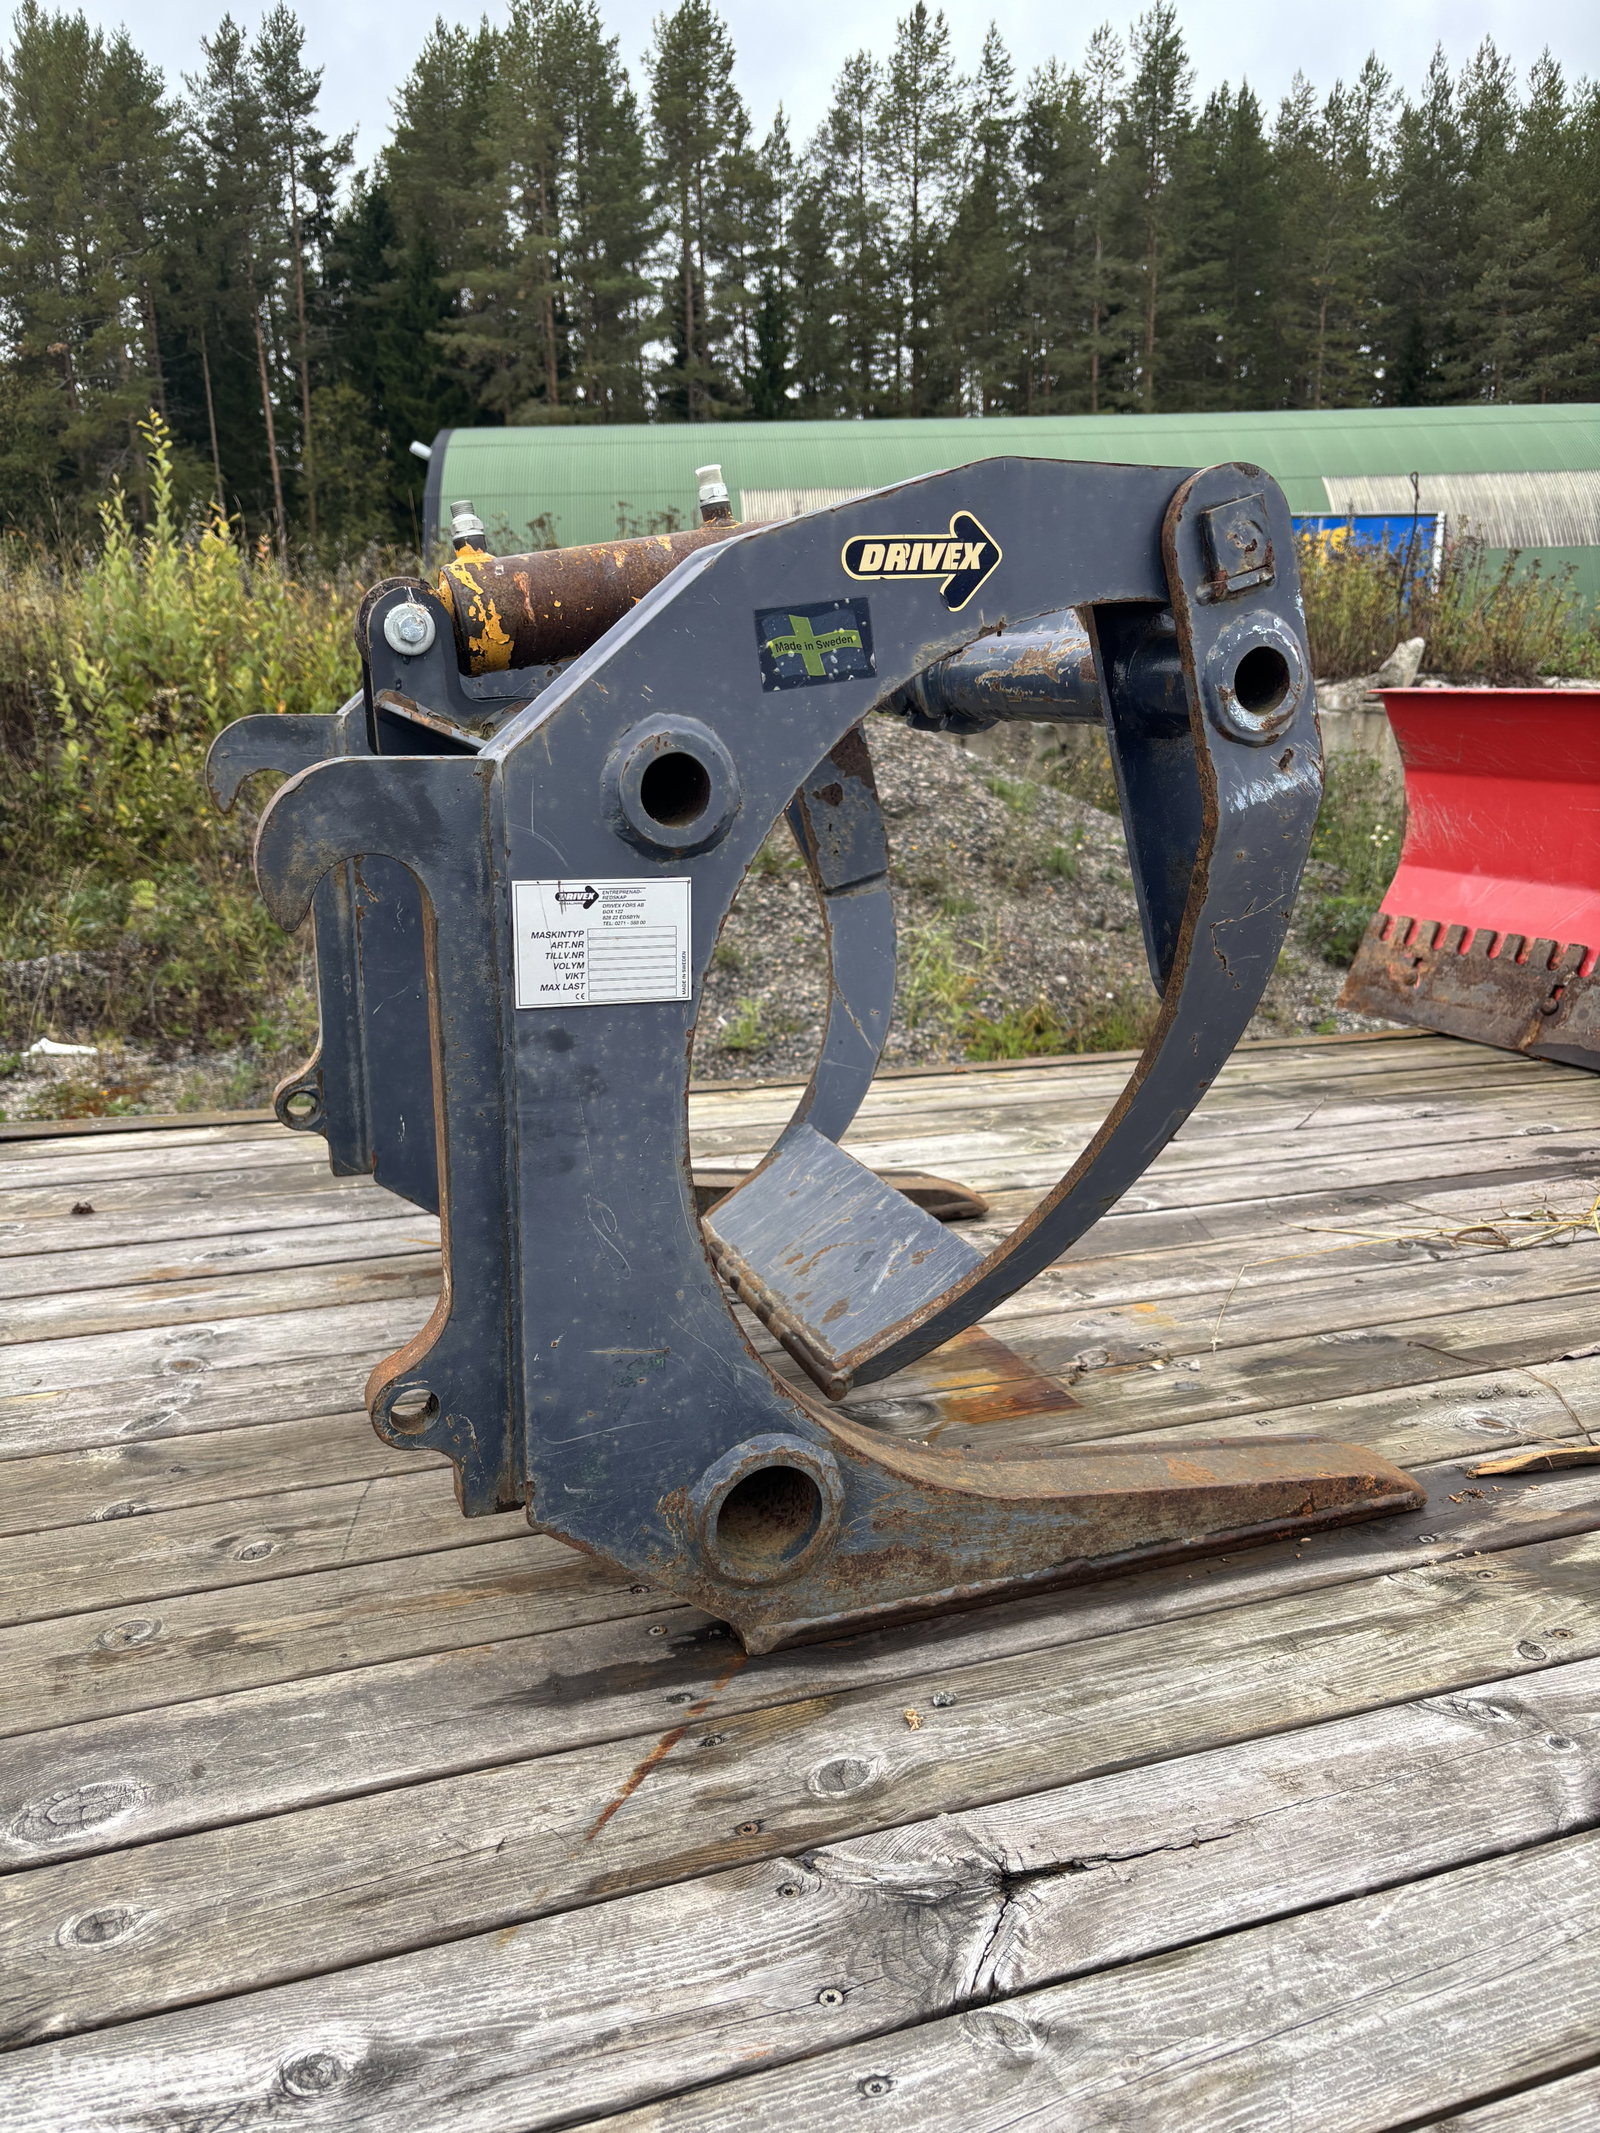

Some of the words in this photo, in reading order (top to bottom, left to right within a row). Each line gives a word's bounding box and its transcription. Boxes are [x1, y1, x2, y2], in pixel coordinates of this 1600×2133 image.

[858, 542, 988, 572] DRIVEX
[774, 641, 802, 653] Made
[804, 641, 814, 651] in
[816, 635, 855, 650] Sweden
[558, 892, 596, 901] DRIVEX
[530, 930, 585, 939] MASKINTYP
[550, 941, 585, 949] ART.NR
[545, 951, 585, 960] TILLV.NR
[553, 962, 585, 970] VOLYM
[565, 972, 586, 980] VIKT
[539, 984, 561, 992] MAX
[562, 982, 586, 990] LAST
